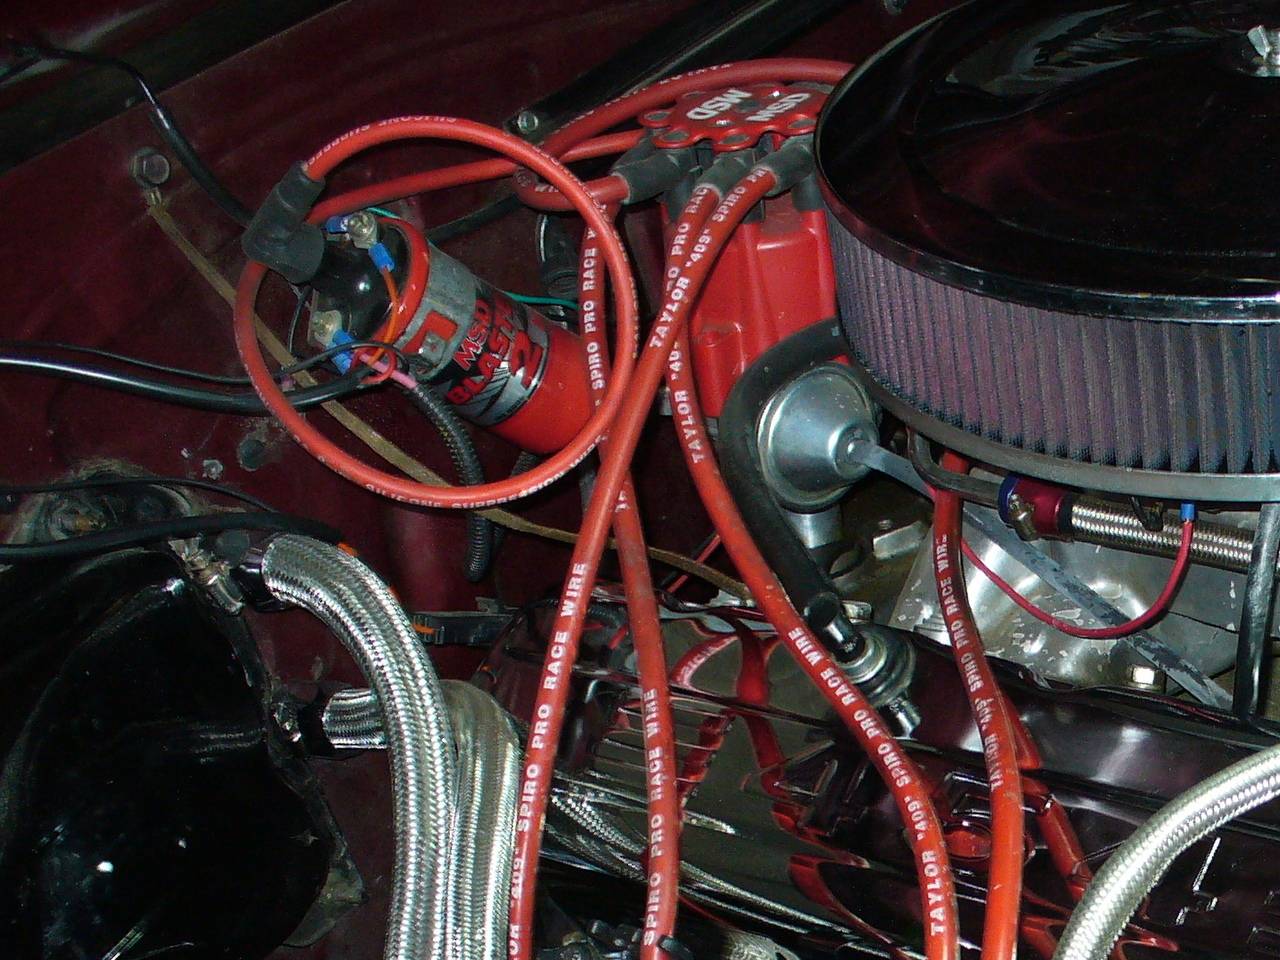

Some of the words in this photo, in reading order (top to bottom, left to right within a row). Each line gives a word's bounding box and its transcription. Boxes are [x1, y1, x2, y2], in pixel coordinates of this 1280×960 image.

[685, 87, 753, 120] MSD
[744, 93, 811, 121] MSD
[671, 221, 690, 257] PRO
[582, 247, 598, 292] RACE
[649, 275, 691, 349] TAYLOR
[711, 185, 746, 224] SPIRO
[453, 299, 492, 371] MSD
[583, 300, 597, 335] PRO
[509, 329, 544, 389] 2
[585, 340, 606, 391] SPIRO
[674, 390, 705, 464] TAYLOR
[939, 576, 961, 617] RACE
[787, 626, 824, 668] WIRE
[950, 619, 972, 651] PRO
[819, 667, 856, 706] RACE
[960, 654, 985, 694] SPIRO
[517, 763, 540, 834] SPIRO
[531, 703, 552, 750] PRO
[543, 630, 570, 690] RACE
[560, 562, 589, 617] WIRE
[644, 688, 662, 738] WIRE
[853, 708, 881, 741] PRO
[649, 746, 665, 801] RACE
[876, 742, 912, 789] SPIRO
[982, 732, 1004, 792] TAYLOR
[650, 813, 665, 858] PRO
[643, 871, 662, 946] SPIRO
[921, 849, 947, 937] TAYLOR
